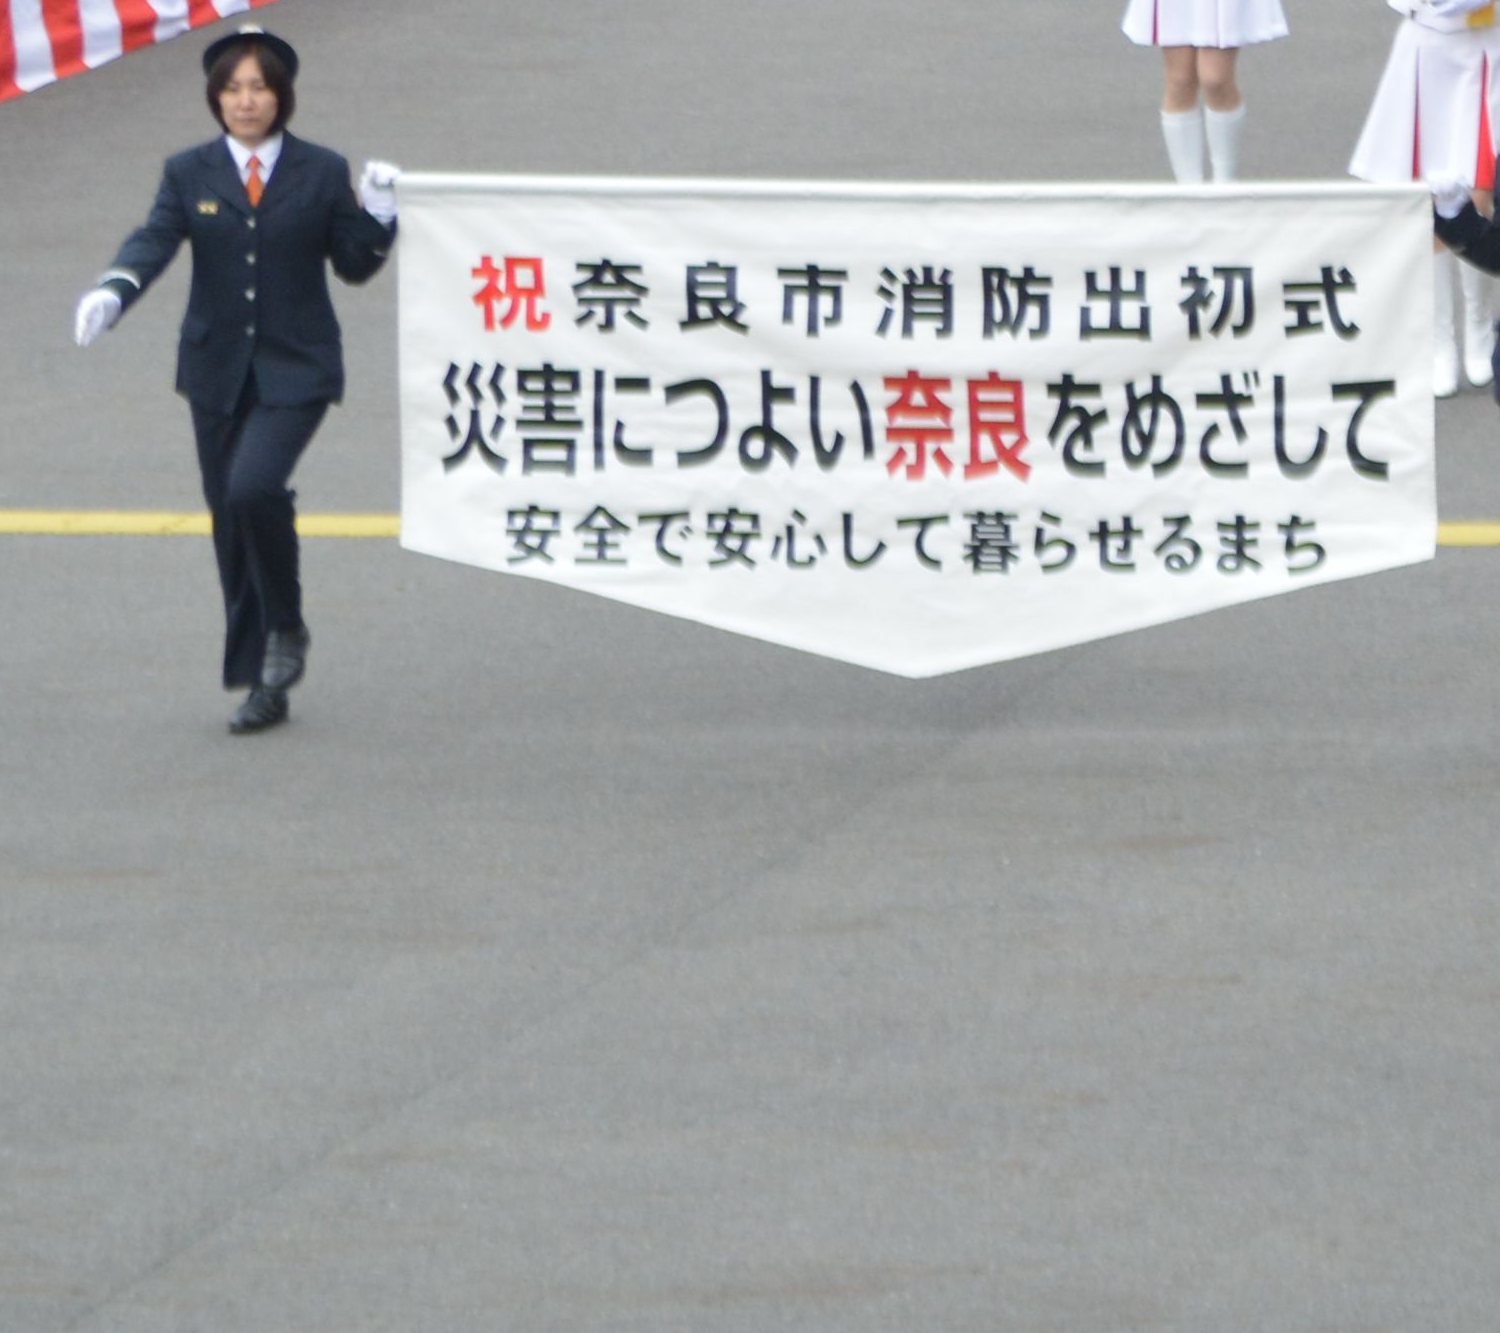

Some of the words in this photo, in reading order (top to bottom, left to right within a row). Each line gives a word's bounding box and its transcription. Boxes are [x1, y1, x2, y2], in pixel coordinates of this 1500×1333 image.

[441, 362, 1398, 483] 災害につよい奈良をめざして
[503, 505, 1329, 576] 安全で安心して暮らせるまち
